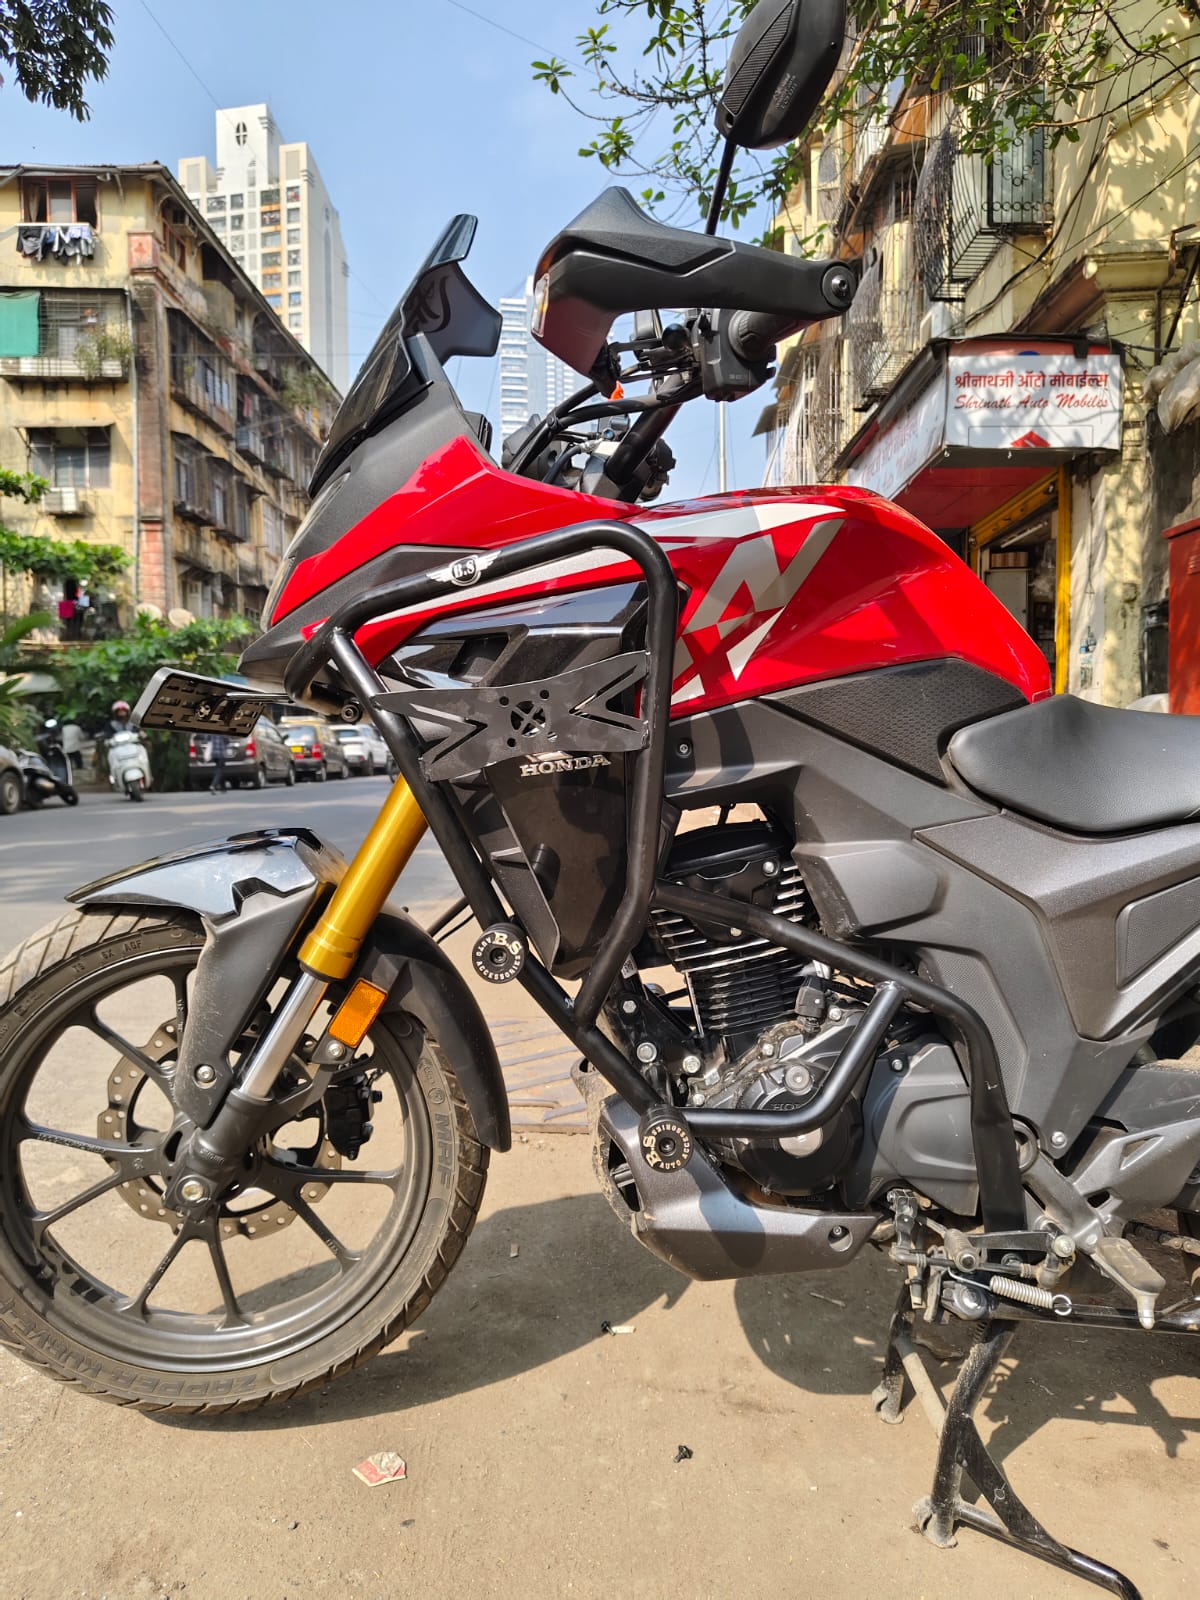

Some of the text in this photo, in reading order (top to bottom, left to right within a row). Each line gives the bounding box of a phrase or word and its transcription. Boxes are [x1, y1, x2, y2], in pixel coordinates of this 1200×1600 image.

[954, 370, 1014, 389] श्रीनाथजी
[1018, 370, 1046, 388] ऑटो
[954, 392, 1108, 409] Shrinath Auto Mobiles
[453, 559, 476, 579] B.S
[519, 754, 612, 777] HONDA
[475, 936, 492, 957] AUTO
[475, 955, 521, 980] ACCESSORIES
[435, 1113, 452, 1189] MRF
[651, 1123, 690, 1160] ACCESSORIES
[659, 1159, 682, 1170] AUTO
[112, 1369, 257, 1397] ZAPPER
